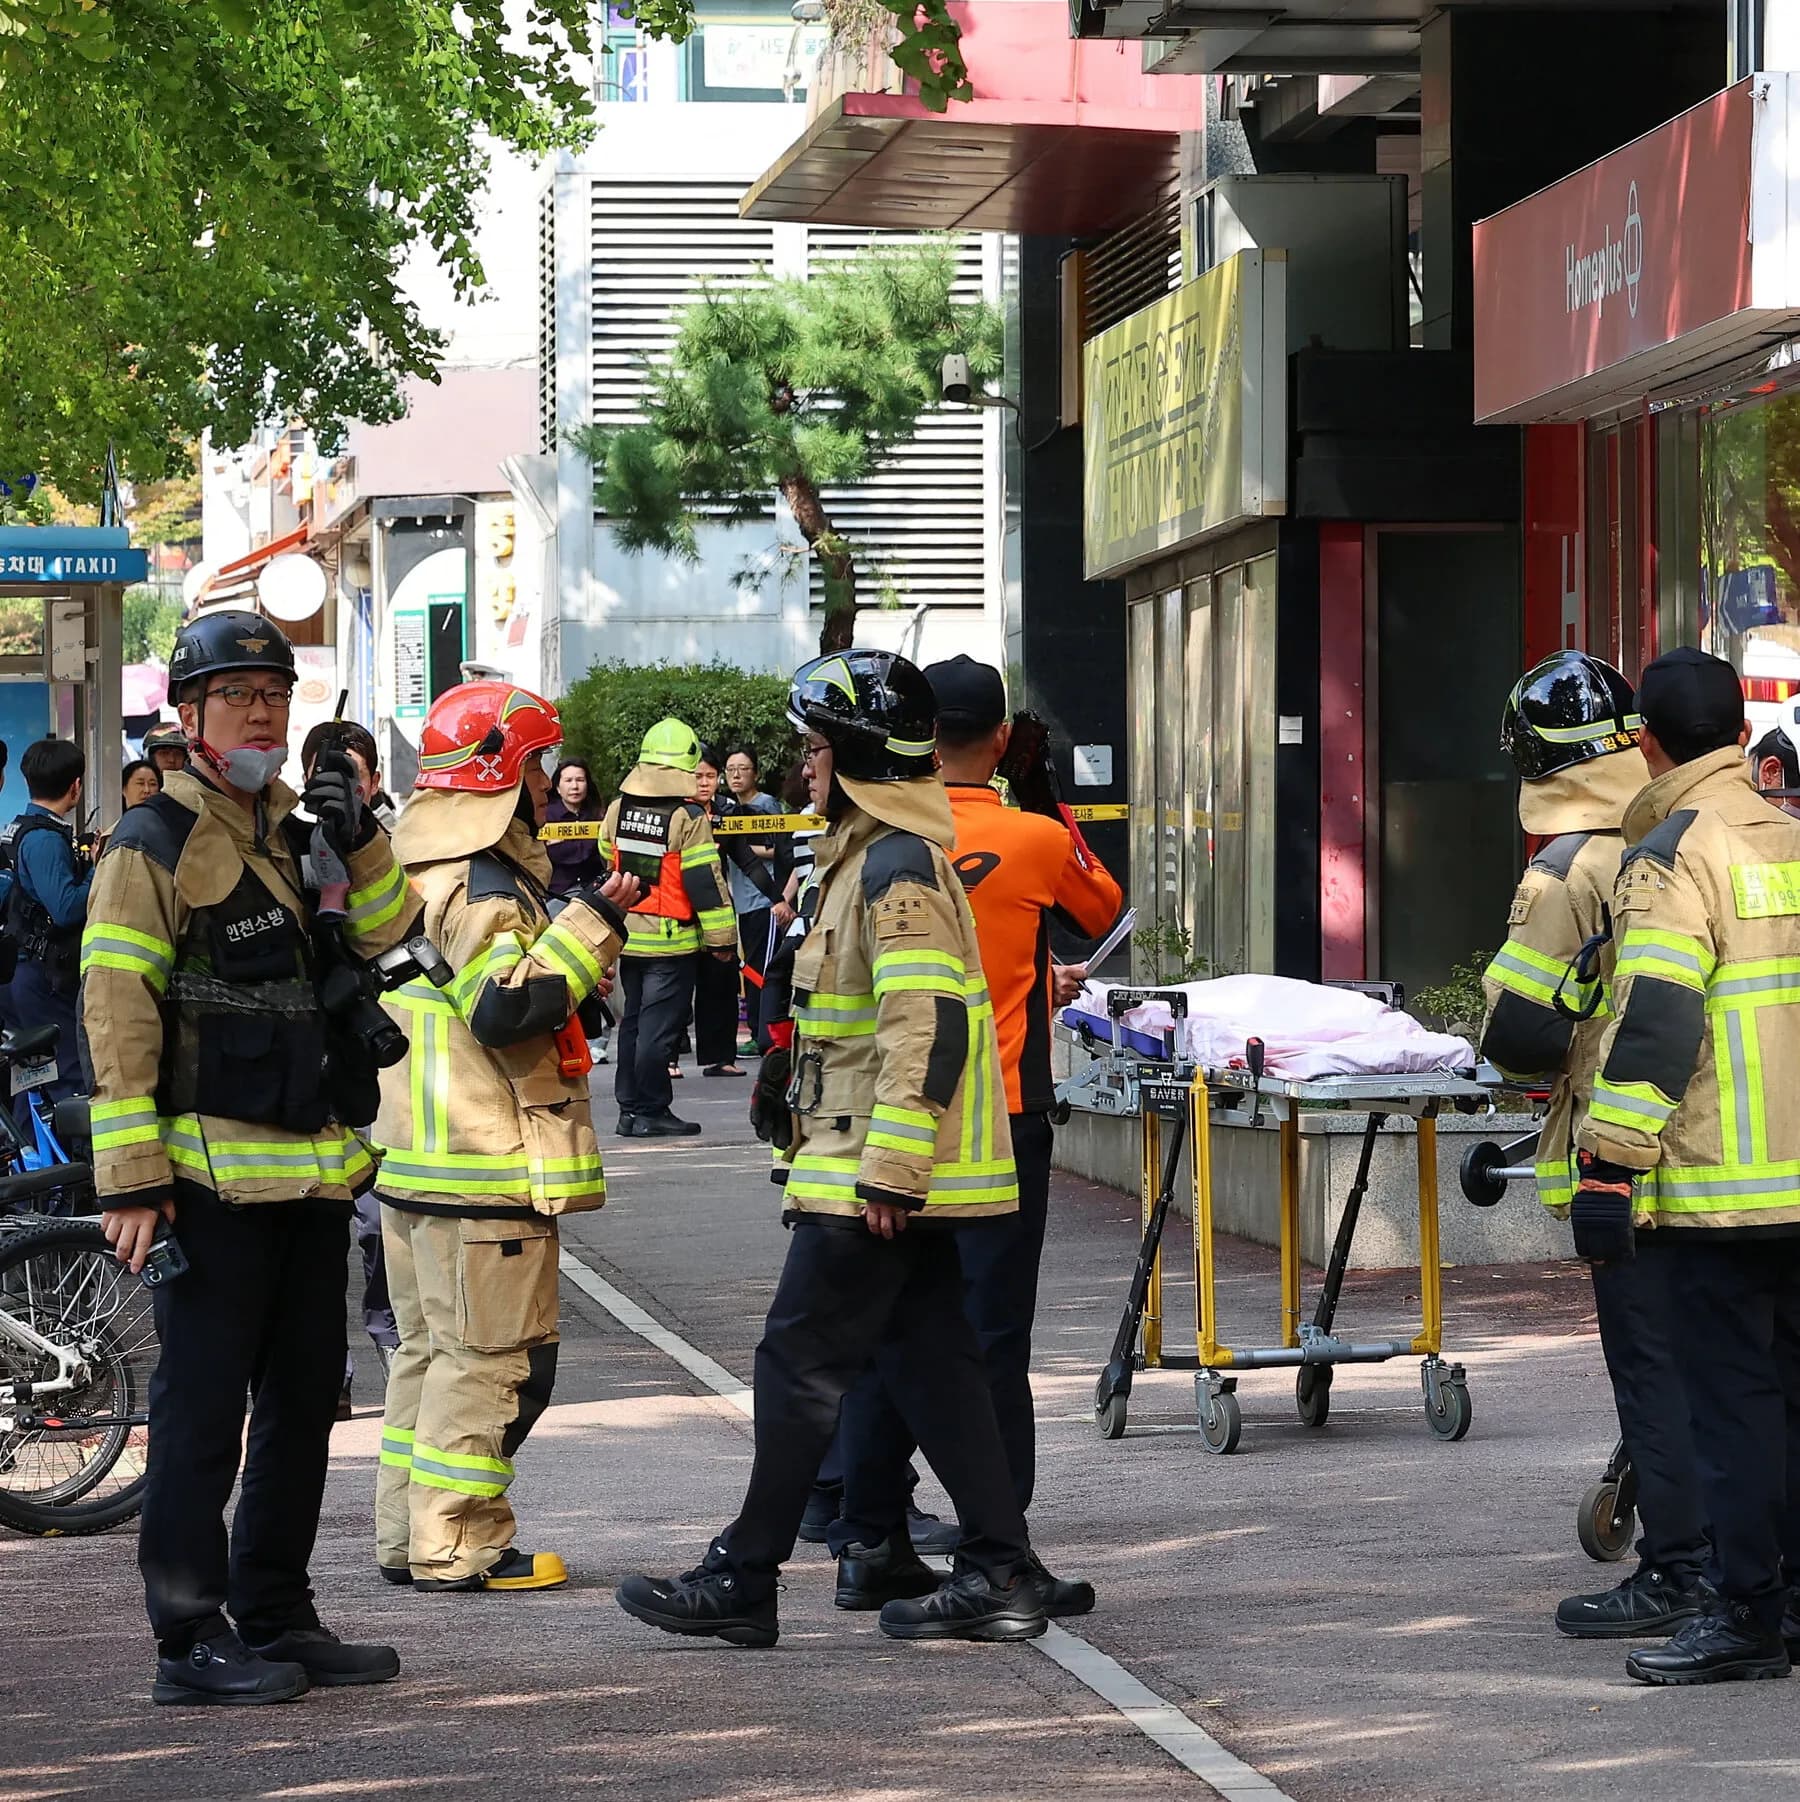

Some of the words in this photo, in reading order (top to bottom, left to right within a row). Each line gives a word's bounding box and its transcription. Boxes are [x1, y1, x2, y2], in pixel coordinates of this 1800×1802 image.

[1566, 224, 1623, 319] Homeplus
[1106, 312, 1205, 448] TARGET
[1107, 422, 1205, 545] HUNTER
[54, 557, 116, 575] (TAXI)
[557, 825, 572, 837] FIRE
[574, 825, 590, 836] LINE
[729, 820, 744, 831] LINE
[751, 817, 786, 831] 화재조사중
[226, 907, 285, 943] 인천소방
